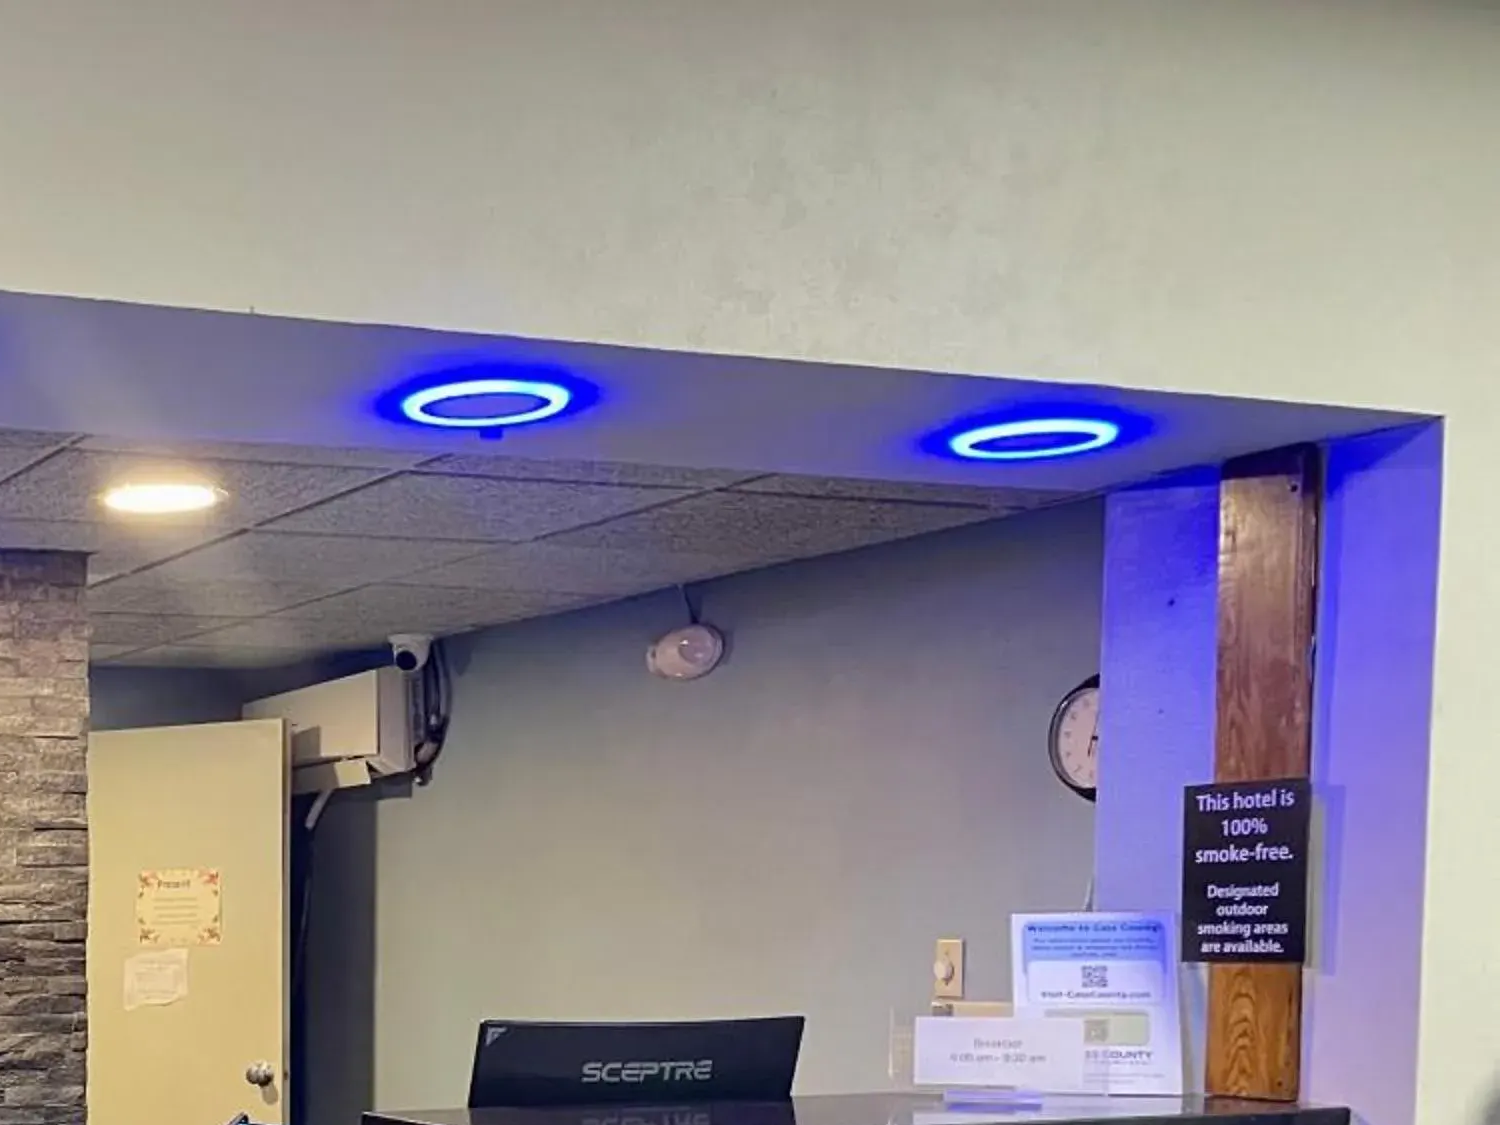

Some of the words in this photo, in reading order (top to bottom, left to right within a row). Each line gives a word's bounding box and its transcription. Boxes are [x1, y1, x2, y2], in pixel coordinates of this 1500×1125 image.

[1195, 793, 1230, 812] This
[1233, 788, 1277, 809] hotel
[1280, 788, 1295, 806] is
[1221, 817, 1268, 836] 100%
[1195, 842, 1294, 863] smoke-free.
[1207, 881, 1280, 900] Designated
[1216, 902, 1268, 916] outdoor
[1197, 921, 1251, 938] smoking
[1253, 923, 1289, 935] areas
[1201, 941, 1221, 953] are
[1223, 939, 1284, 953] available.
[581, 1060, 713, 1082] SCEPTRE
